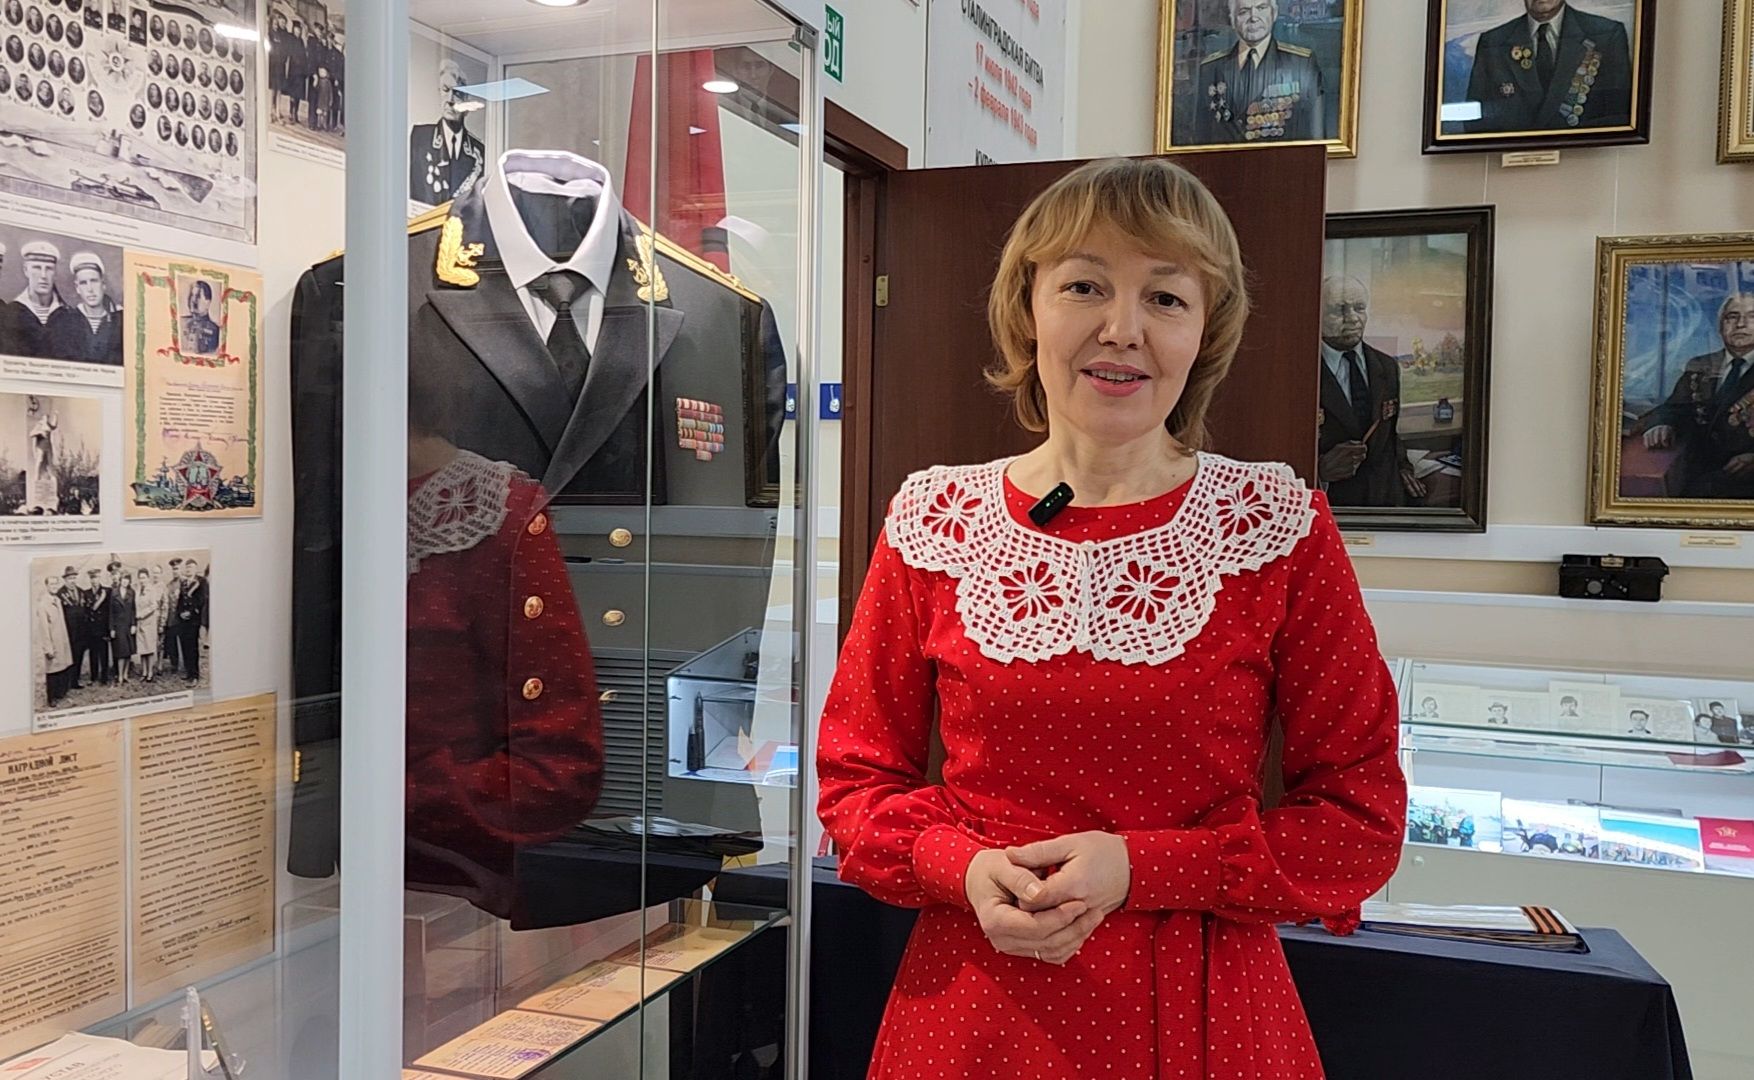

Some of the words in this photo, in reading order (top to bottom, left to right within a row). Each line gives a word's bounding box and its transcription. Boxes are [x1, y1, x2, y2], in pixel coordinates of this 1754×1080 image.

[961, 0, 1023, 68] СТАЛИНГРАДСКАЯ
[1025, 51, 1043, 88] БИТВА
[976, 41, 984, 66] 17
